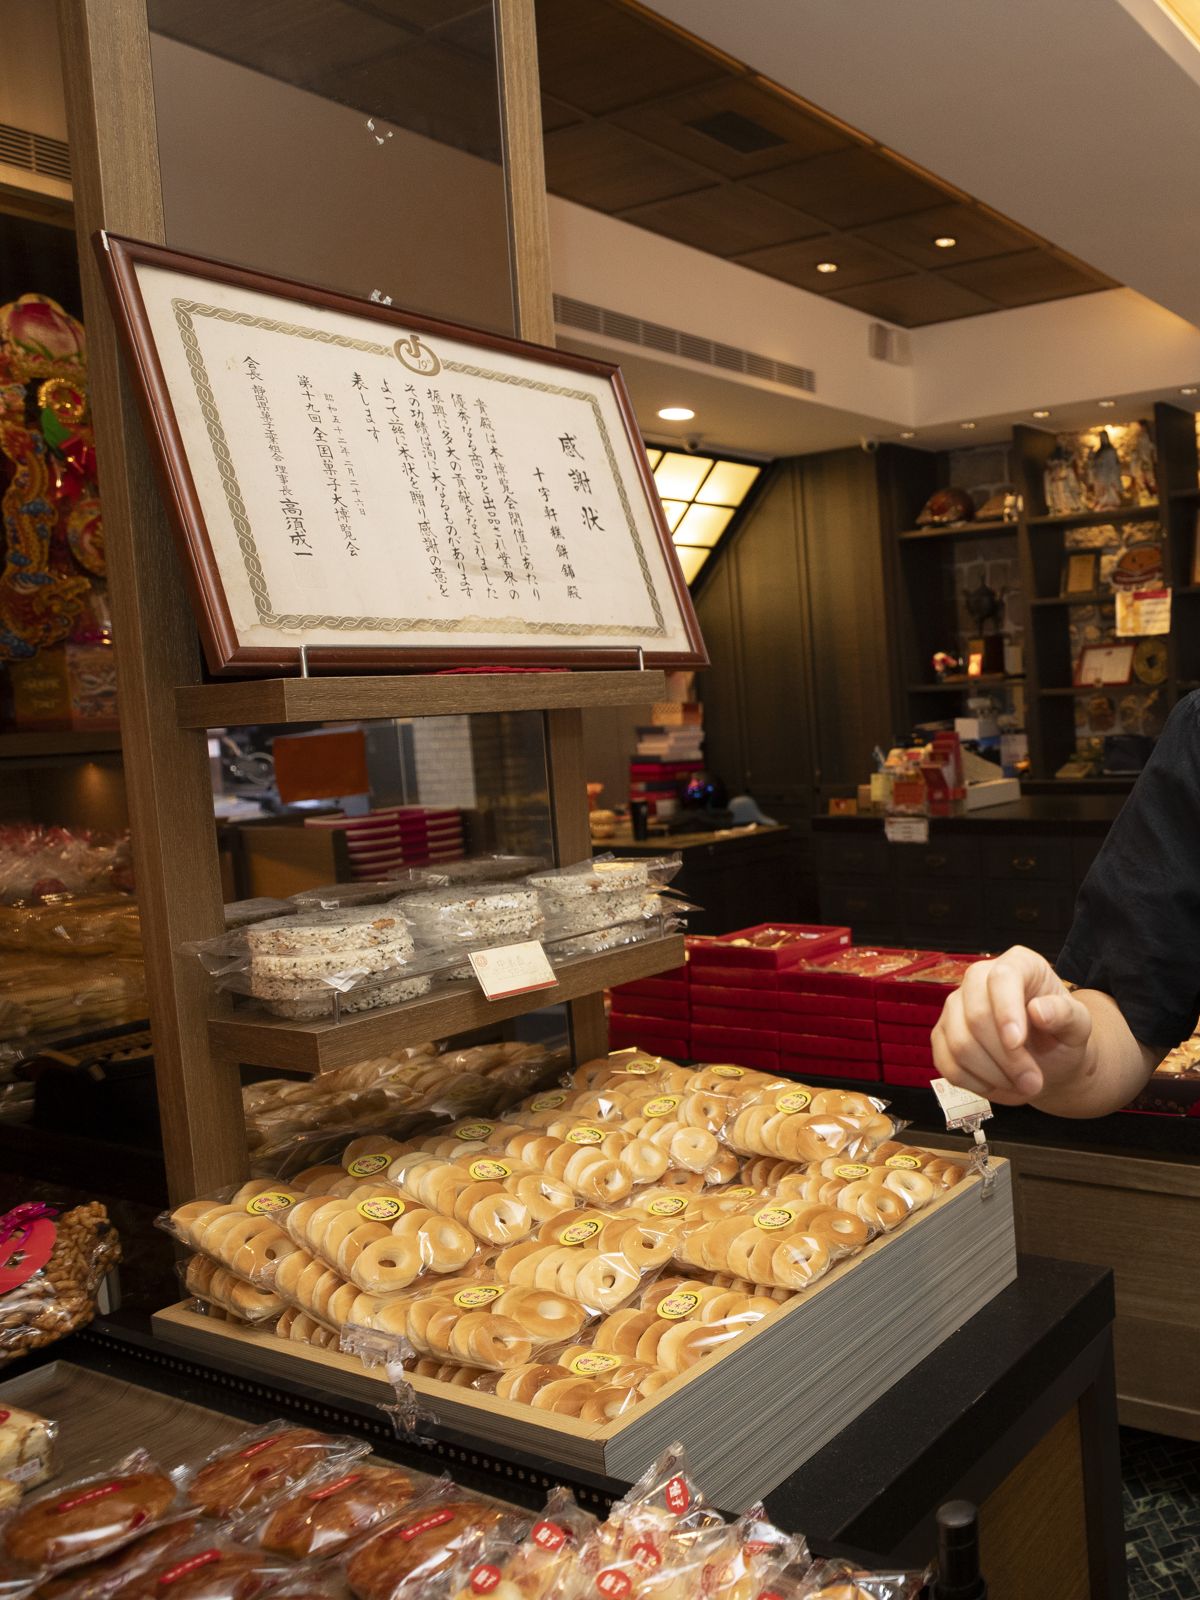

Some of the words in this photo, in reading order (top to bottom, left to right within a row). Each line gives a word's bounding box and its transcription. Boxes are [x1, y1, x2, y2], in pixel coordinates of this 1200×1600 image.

[243, 355, 264, 381] 会長
[351, 371, 381, 443] 表します
[557, 432, 606, 532] 感謝状
